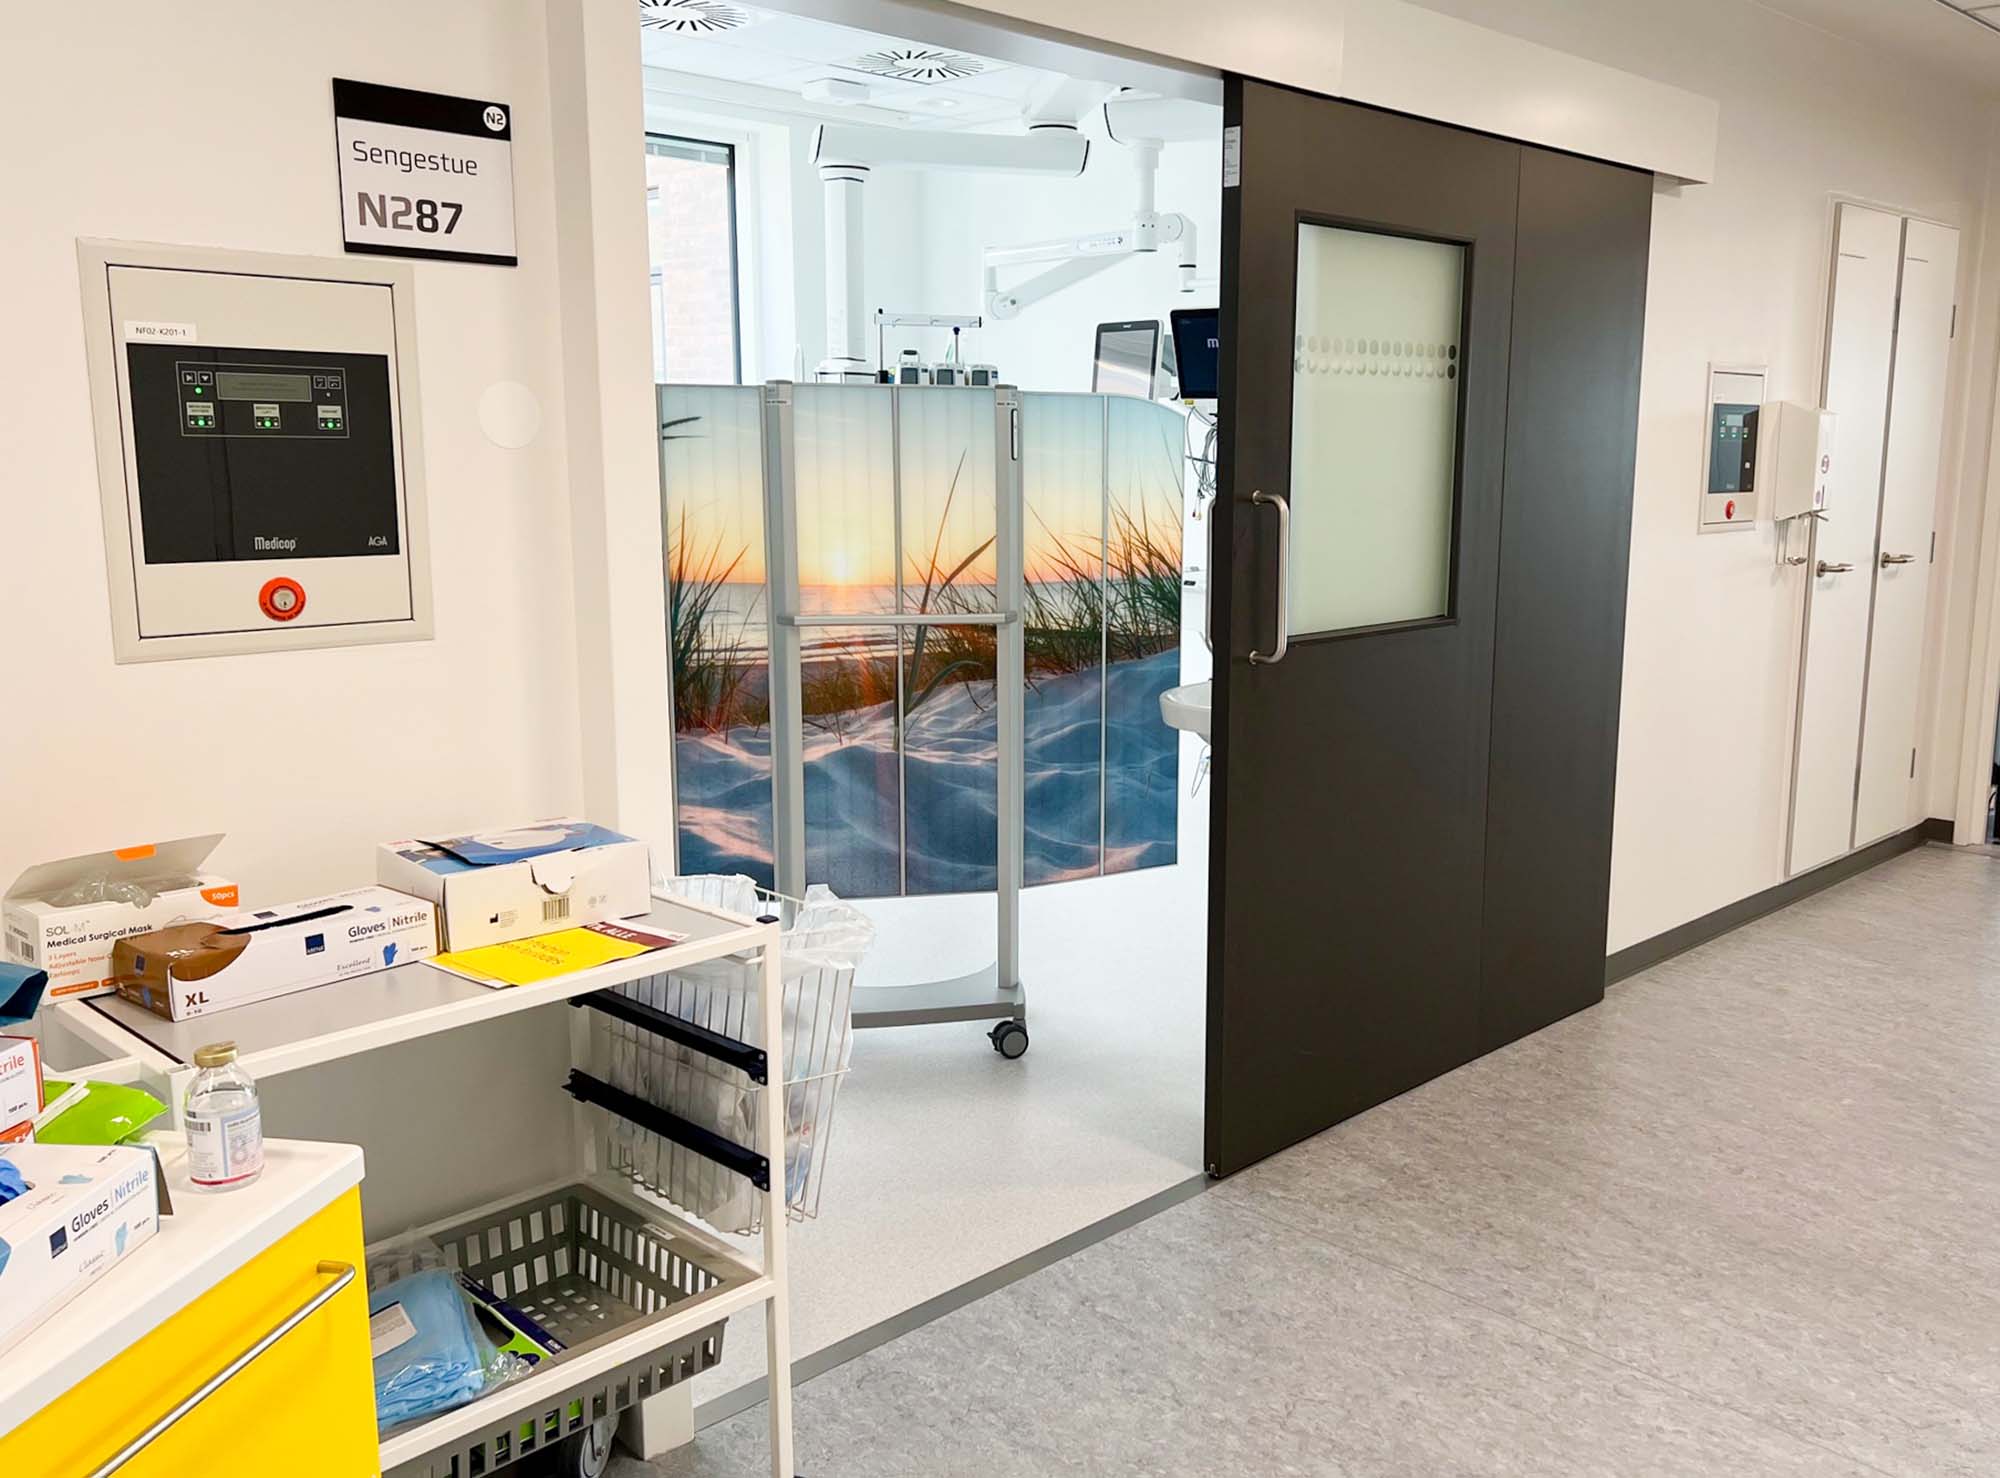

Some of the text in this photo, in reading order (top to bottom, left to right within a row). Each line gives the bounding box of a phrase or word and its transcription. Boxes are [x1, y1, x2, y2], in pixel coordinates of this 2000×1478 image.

[486, 112, 504, 125] N2
[352, 140, 478, 176] Sengestue
[357, 191, 463, 235] N287
[254, 536, 297, 551] Medicop
[368, 536, 388, 547] AGA
[47, 923, 153, 949] Medical Surgical Mask
[348, 920, 386, 938] Gloves
[392, 911, 428, 928] Nitrile
[185, 991, 210, 1007] XL
[71, 1199, 109, 1233] Gloves
[114, 1168, 149, 1202] Nitrile
